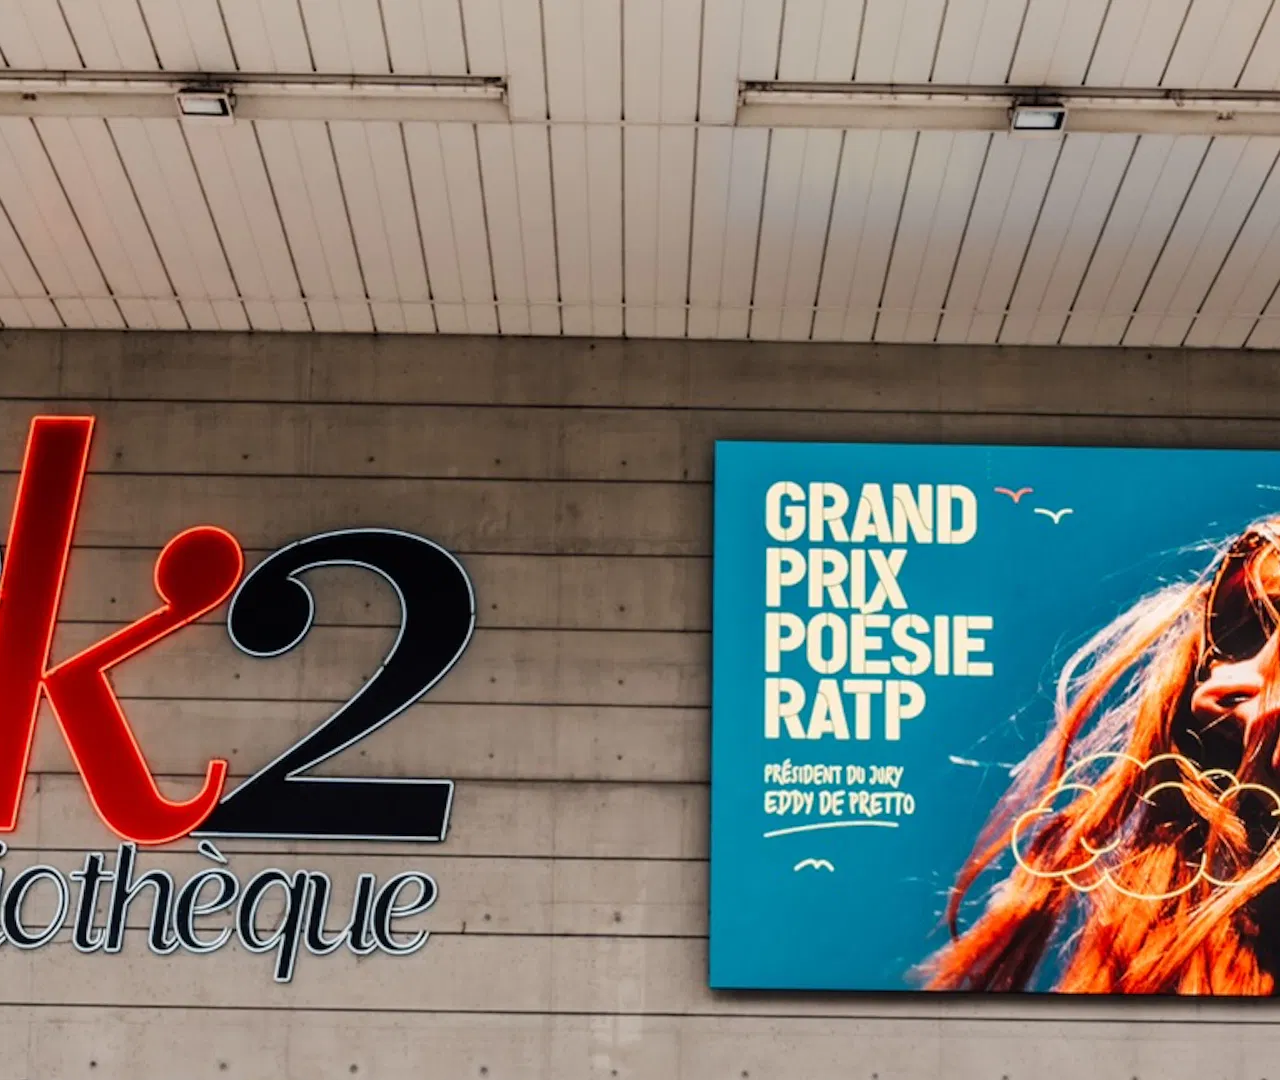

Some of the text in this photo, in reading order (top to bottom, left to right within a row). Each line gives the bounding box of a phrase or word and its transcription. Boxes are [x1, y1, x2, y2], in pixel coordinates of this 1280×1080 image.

[765, 480, 977, 544] GRAND
[765, 547, 908, 611] PRIX
[764, 602, 994, 677] POÉSIE
[764, 678, 927, 741] RATP
[763, 758, 904, 789] PRÉSIDENT DU JURY
[763, 790, 916, 818] EDDY DE PRETTO
